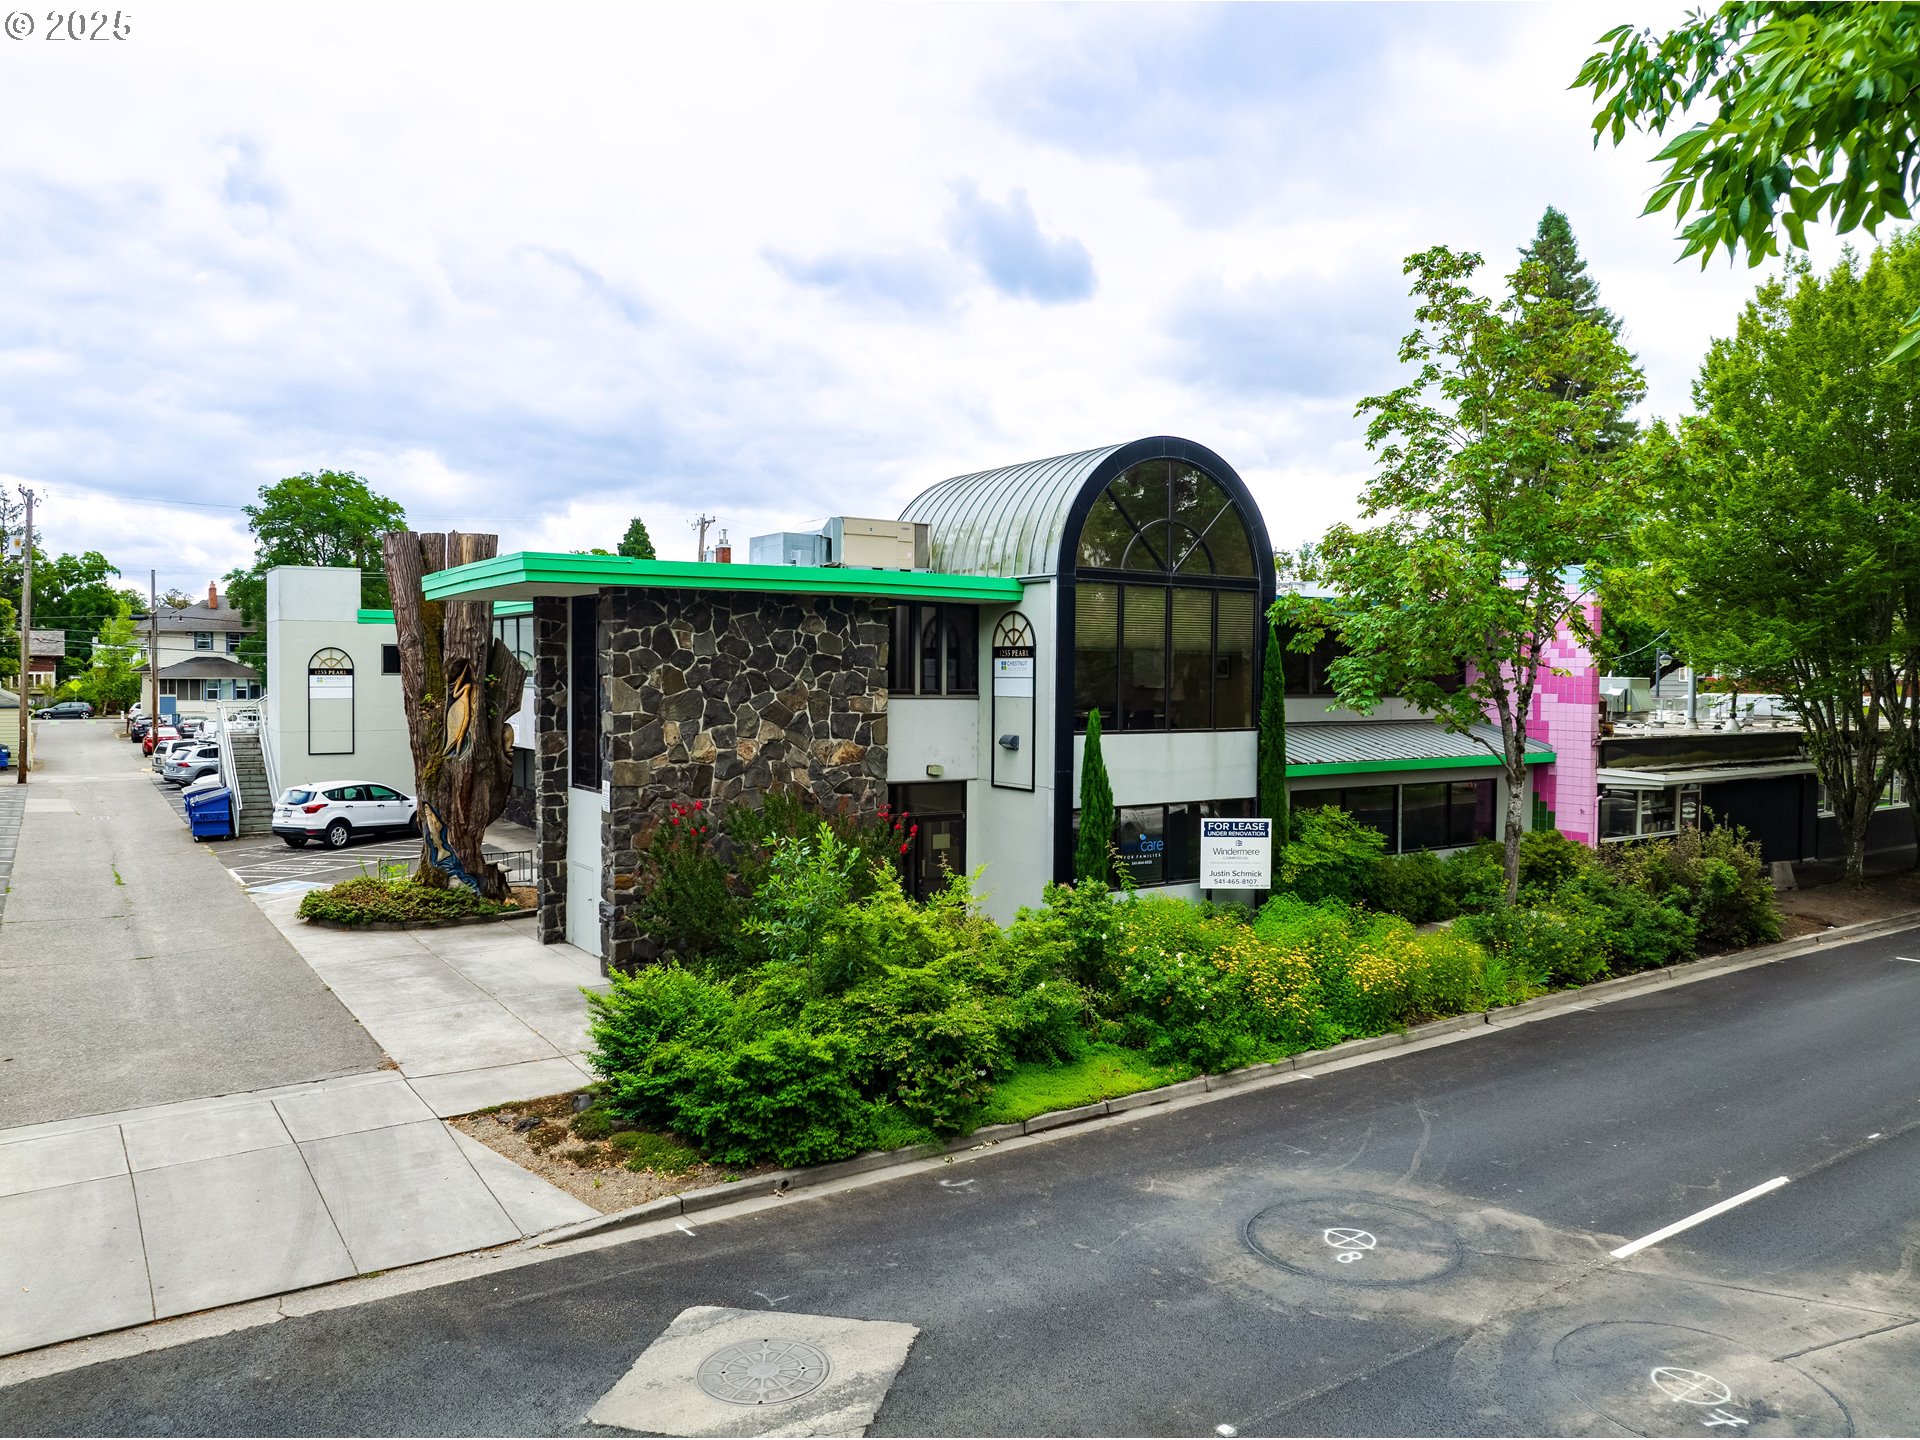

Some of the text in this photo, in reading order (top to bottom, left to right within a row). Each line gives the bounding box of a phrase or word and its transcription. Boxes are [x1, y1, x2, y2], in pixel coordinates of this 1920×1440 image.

[1208, 822, 1265, 831] FOR LEASE
[1212, 848, 1260, 856] Windermere
